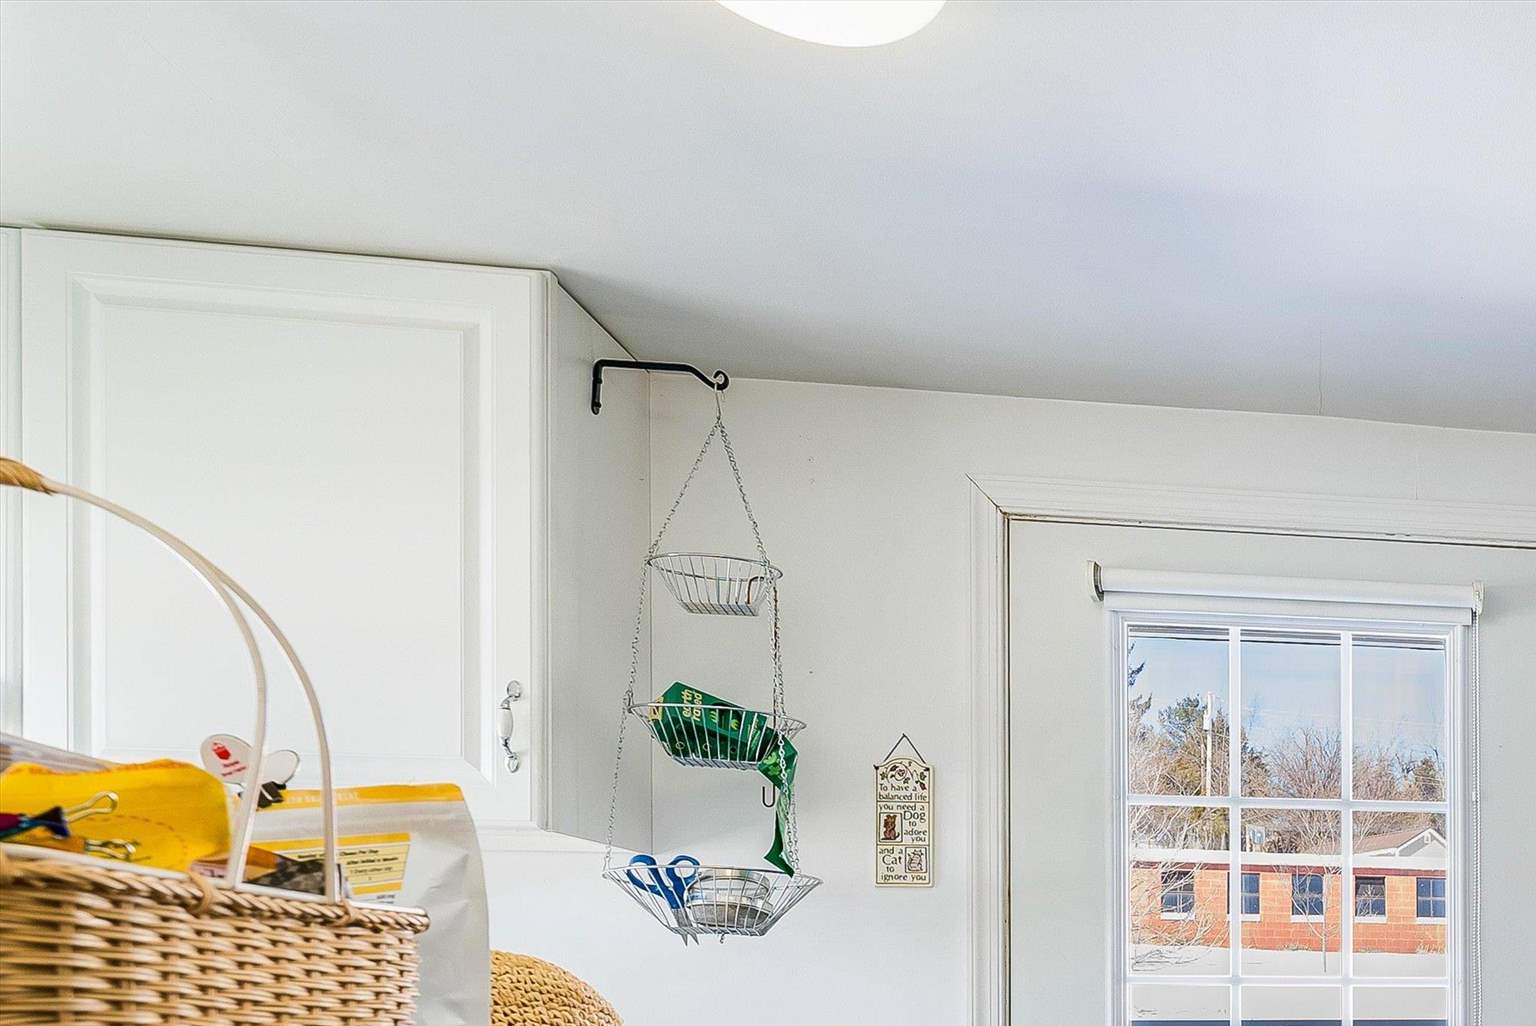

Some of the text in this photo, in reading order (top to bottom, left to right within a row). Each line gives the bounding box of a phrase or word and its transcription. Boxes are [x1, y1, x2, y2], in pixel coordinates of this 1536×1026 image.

[681, 688, 692, 718] earth
[879, 783, 888, 792] To
[890, 783, 909, 792] have
[879, 792, 927, 801] balanced life
[879, 804, 894, 812] you
[896, 803, 917, 811] need
[904, 811, 926, 823] Dog
[904, 828, 927, 836] adore
[879, 847, 895, 855] and
[882, 856, 902, 865] Cat
[886, 865, 895, 873] to
[881, 873, 927, 882] ignore you
